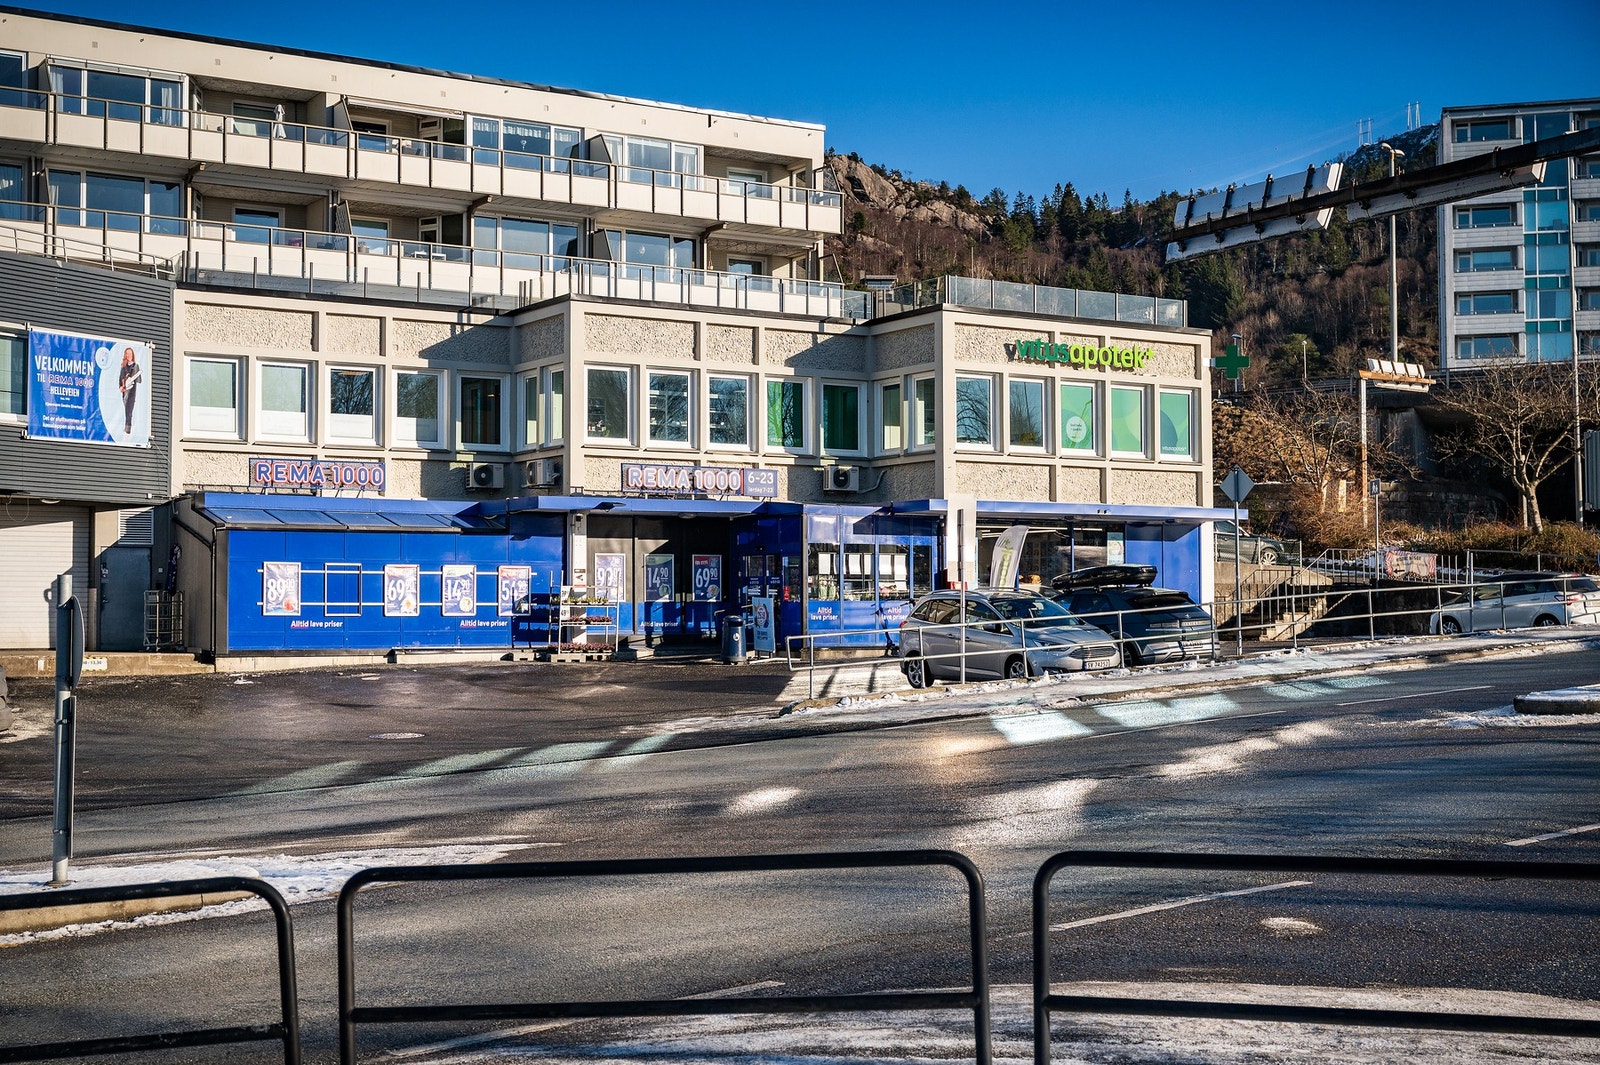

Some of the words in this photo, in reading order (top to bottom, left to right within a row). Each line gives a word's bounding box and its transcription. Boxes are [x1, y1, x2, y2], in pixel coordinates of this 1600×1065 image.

[35, 355, 94, 376] VELKOMMEN
[37, 372, 46, 383] TIL
[48, 373, 73, 386] REMA
[75, 376, 95, 388] 1000
[50, 386, 80, 397] HELLEVEIEN
[255, 461, 326, 484] REMA
[330, 464, 384, 486] 1000
[628, 467, 690, 488] REMA
[694, 469, 741, 491] 1000
[747, 471, 774, 484] 6-23
[647, 567, 661, 588] 14
[660, 567, 669, 578] 90
[695, 567, 710, 588] 69
[710, 567, 718, 578] 90
[267, 578, 286, 602] 89
[388, 579, 405, 601] 69
[446, 579, 461, 601] 14
[461, 579, 470, 590] 90
[817, 606, 832, 615] Alltid
[822, 613, 838, 621] priser
